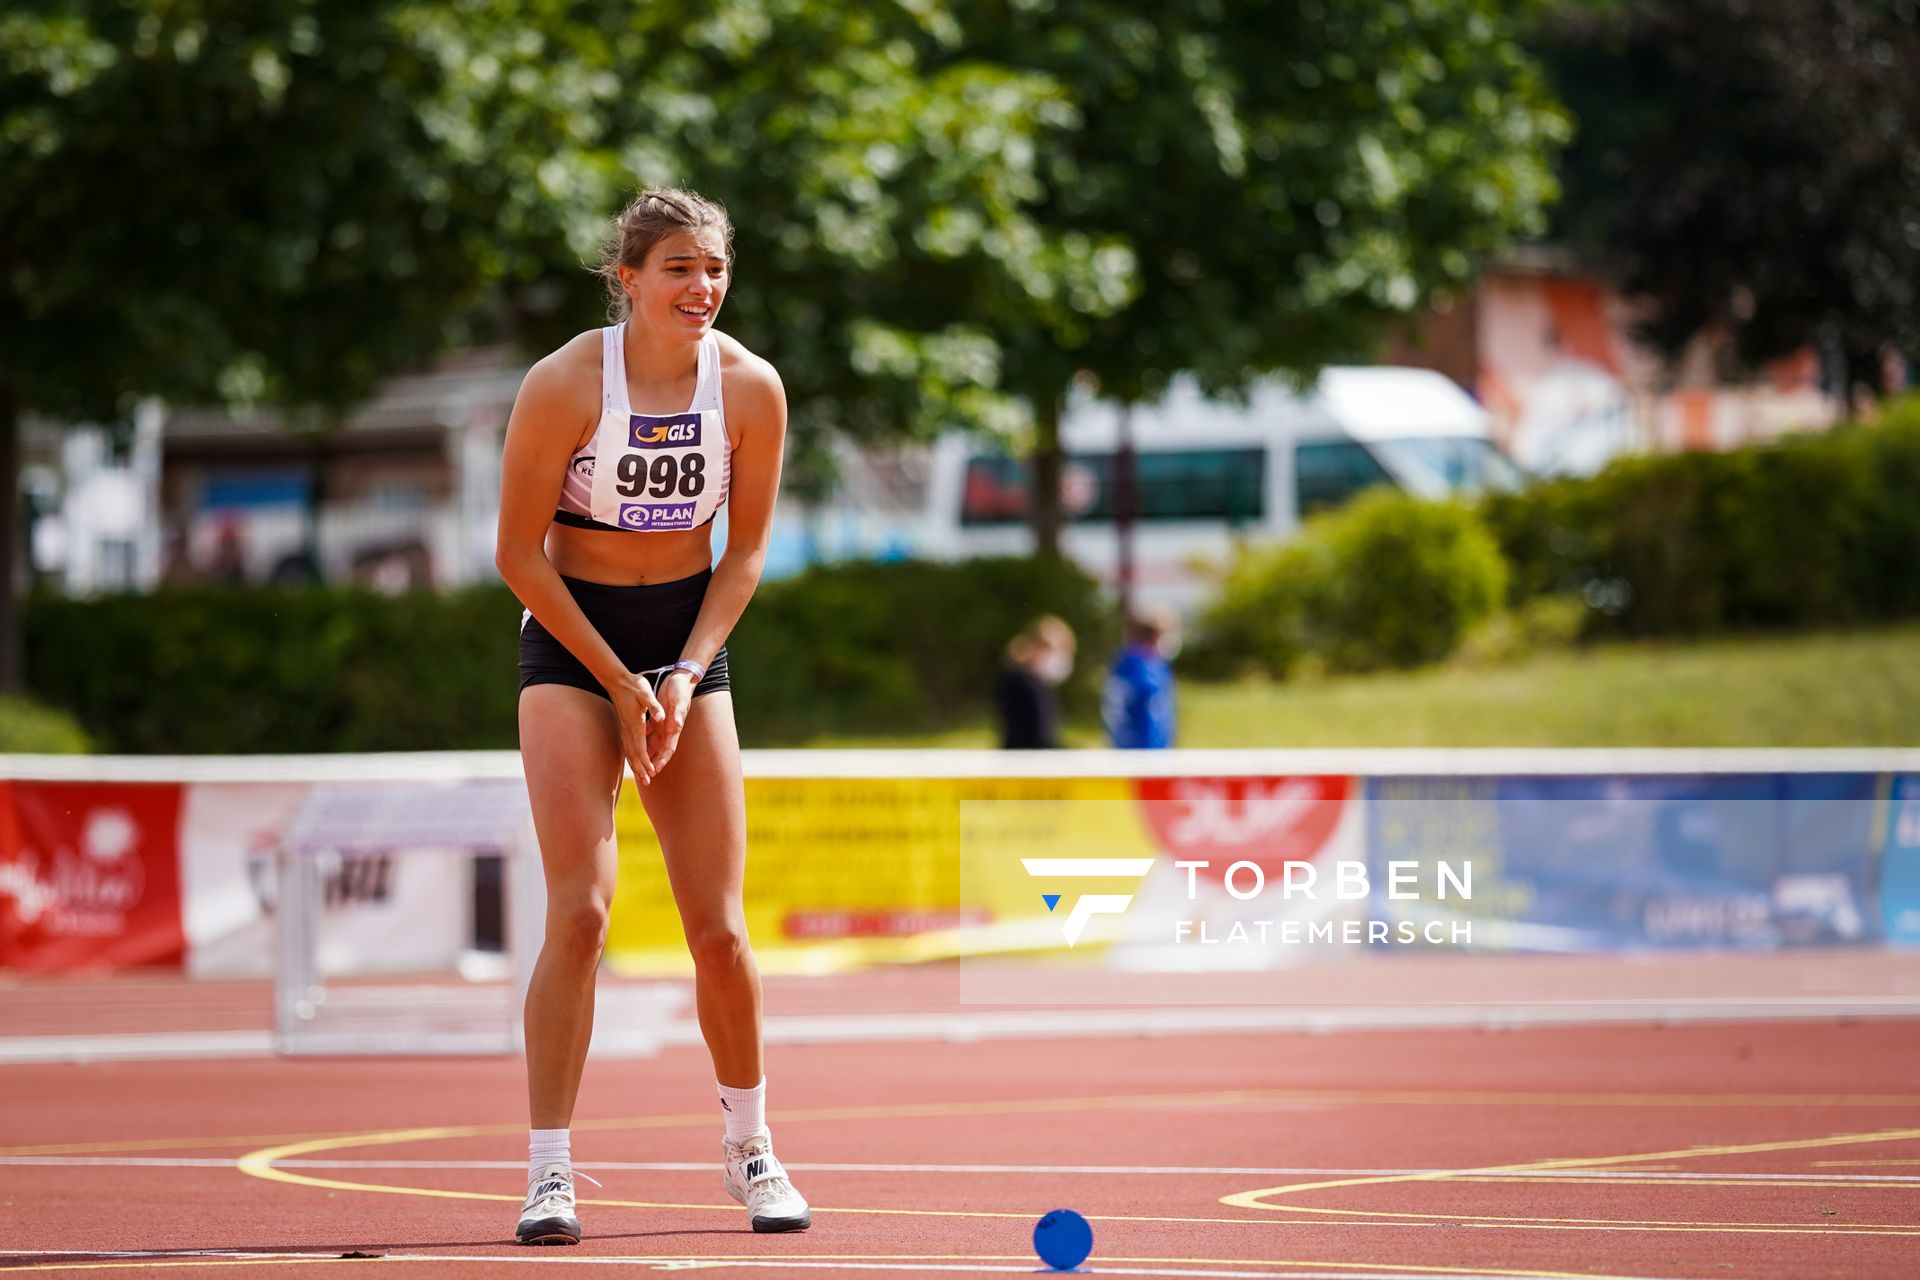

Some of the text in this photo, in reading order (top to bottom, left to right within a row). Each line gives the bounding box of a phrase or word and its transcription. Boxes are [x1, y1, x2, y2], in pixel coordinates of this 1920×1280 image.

[668, 424, 696, 441] GLS
[616, 452, 706, 499] 998
[651, 507, 693, 520] PLAN
